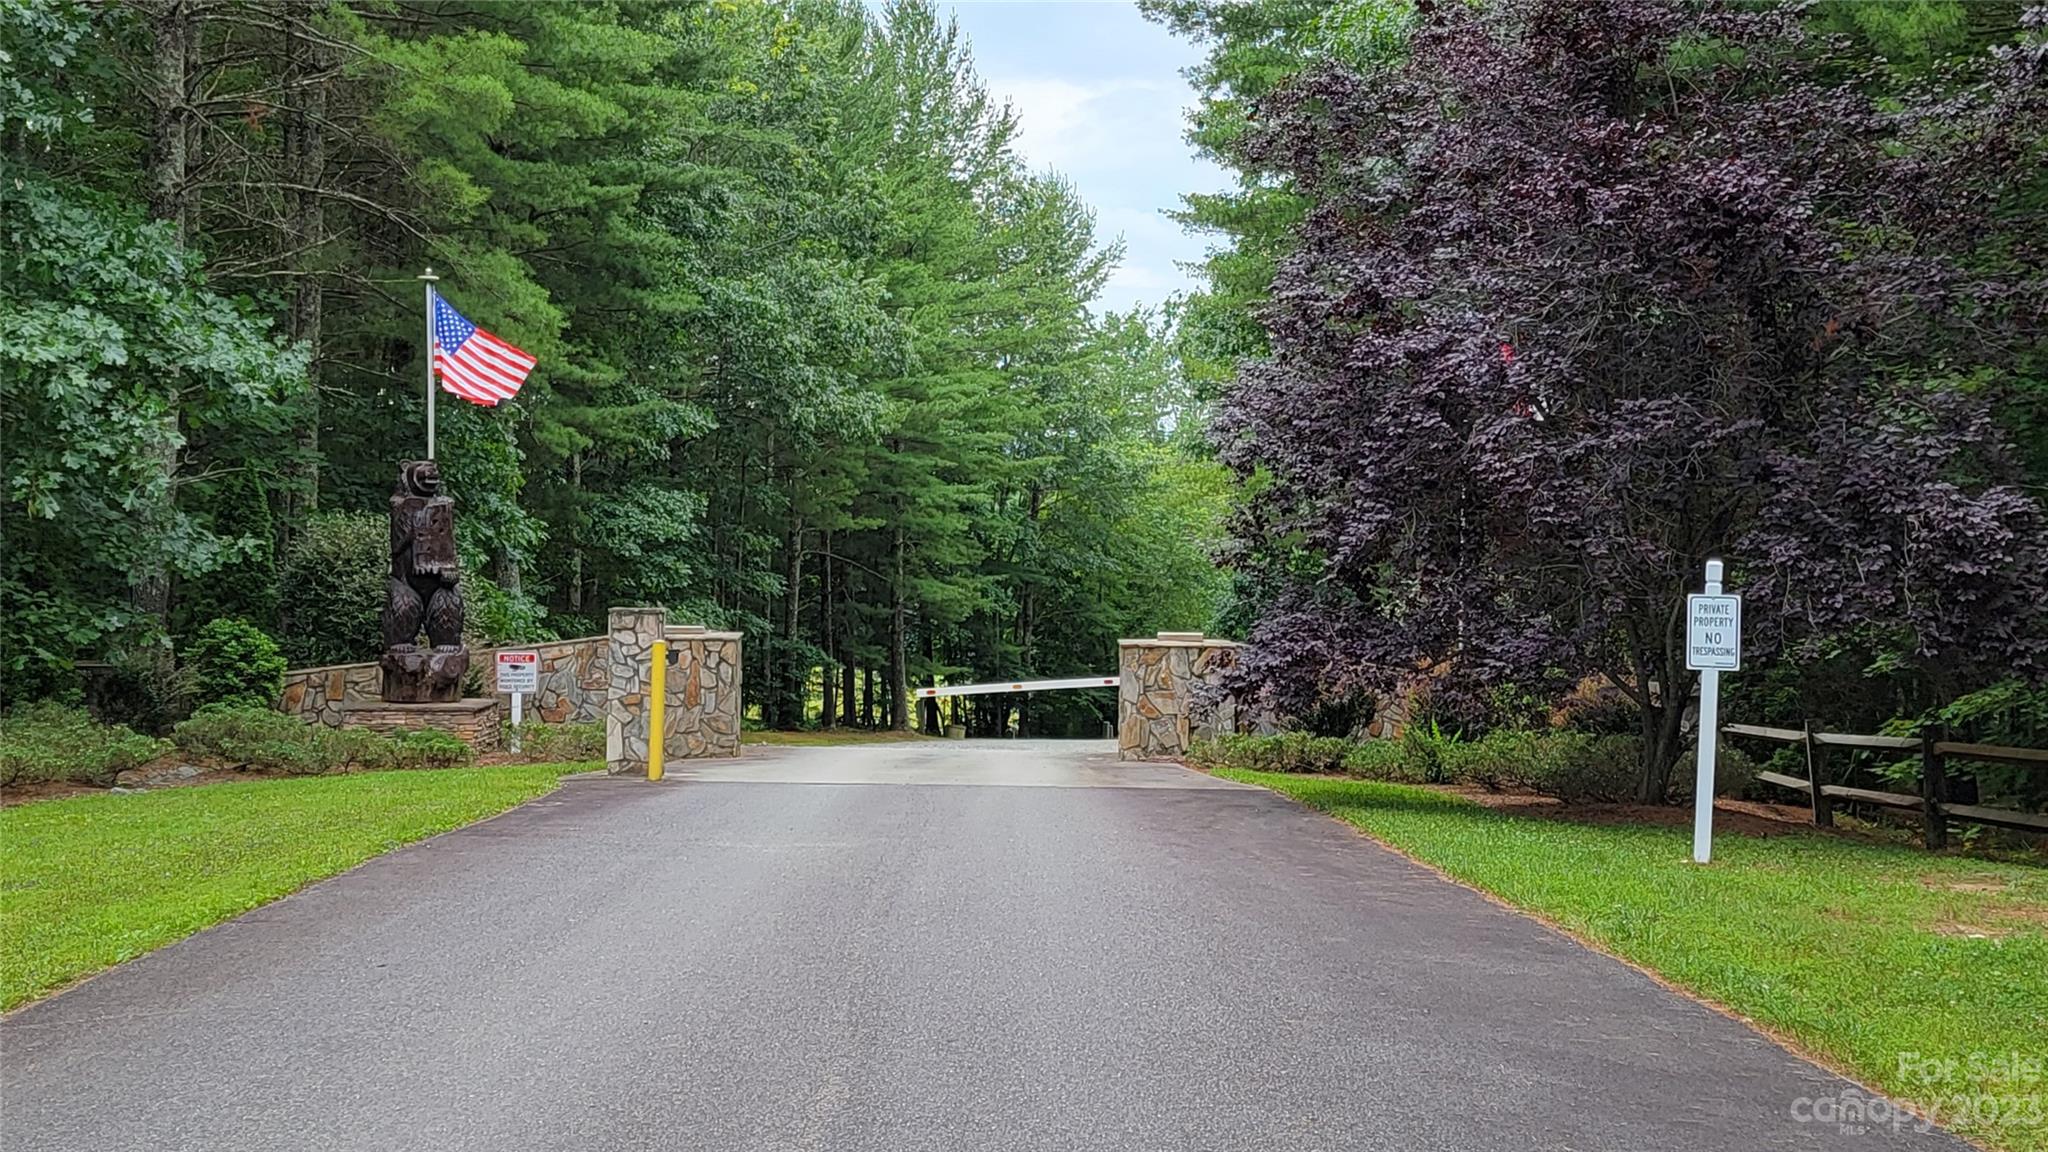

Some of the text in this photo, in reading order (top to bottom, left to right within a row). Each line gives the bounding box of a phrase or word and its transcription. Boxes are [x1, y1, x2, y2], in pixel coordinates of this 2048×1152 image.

[1698, 603, 1730, 615] PRIVATE
[1693, 616, 1734, 628] PROPERTY
[1704, 632, 1722, 645] NO
[1692, 646, 1735, 657] TRESPASSING
[503, 655, 530, 663] NOTICE
